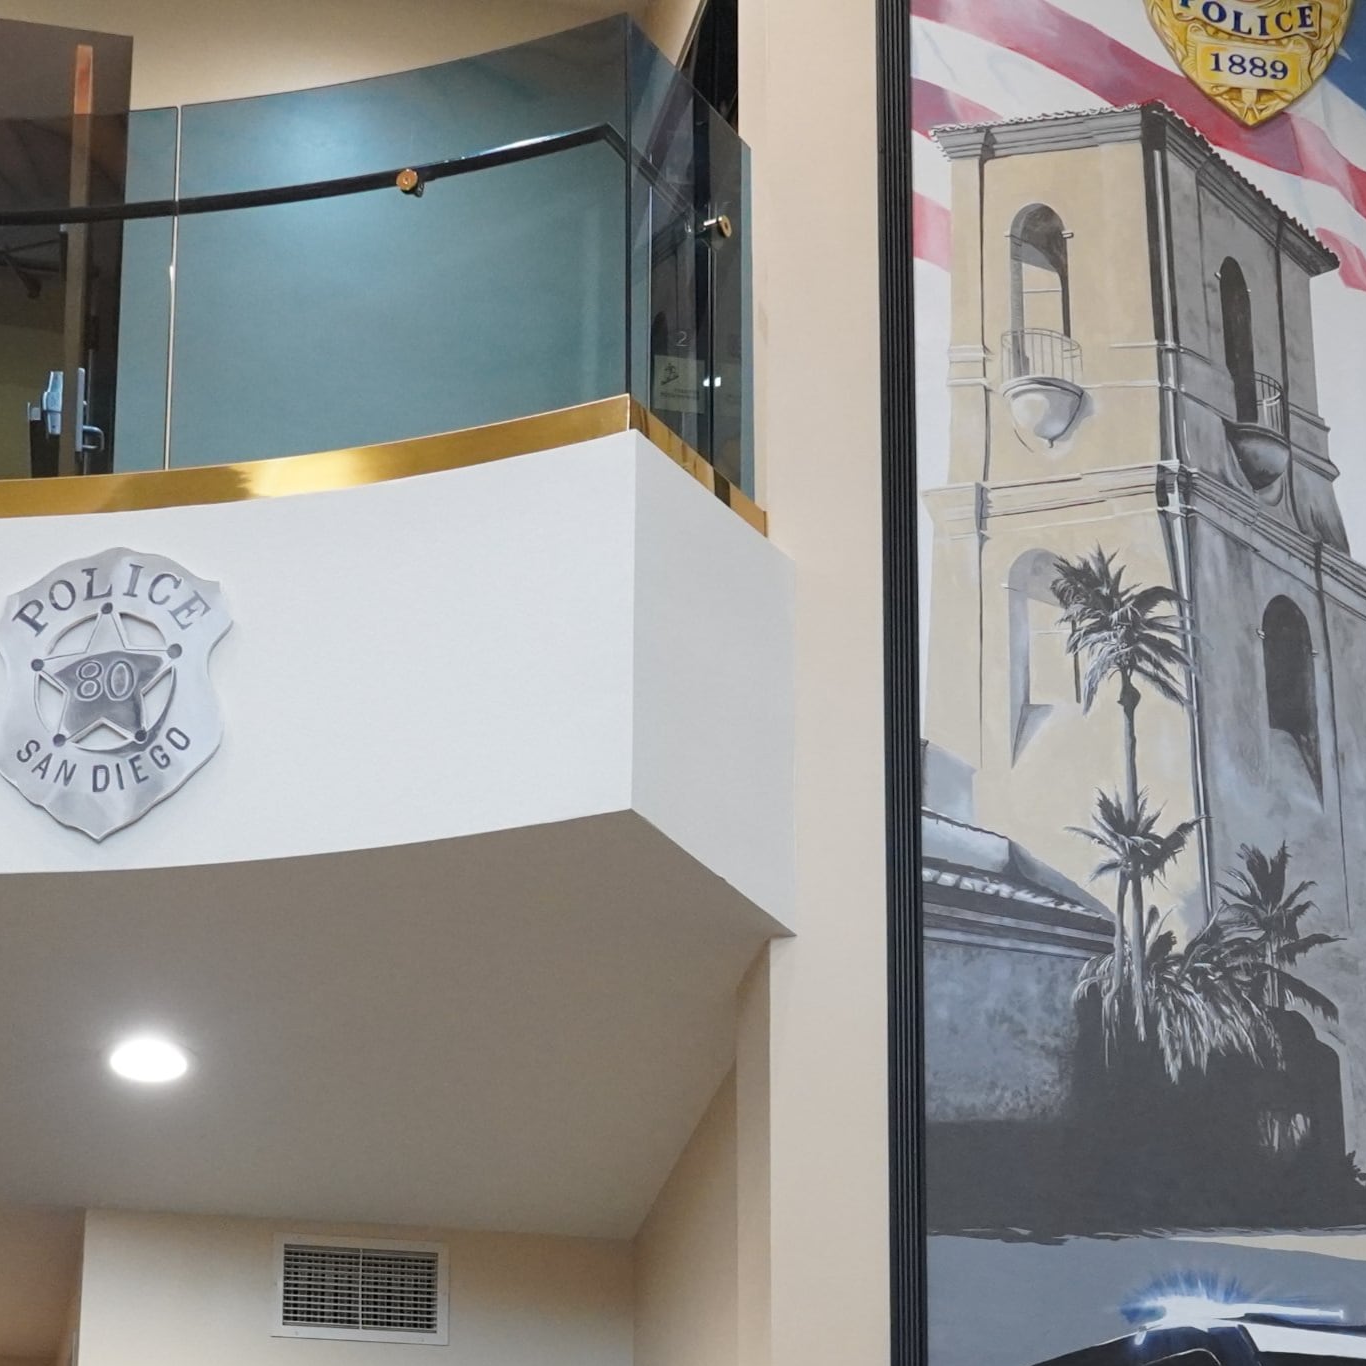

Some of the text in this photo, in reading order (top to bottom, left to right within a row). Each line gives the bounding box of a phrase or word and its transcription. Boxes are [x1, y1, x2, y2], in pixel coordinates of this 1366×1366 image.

[1210, 52, 1289, 80] 1889
[12, 563, 212, 637] POLICE
[76, 660, 135, 702] 80
[16, 726, 191, 793] SAN DIEGO
